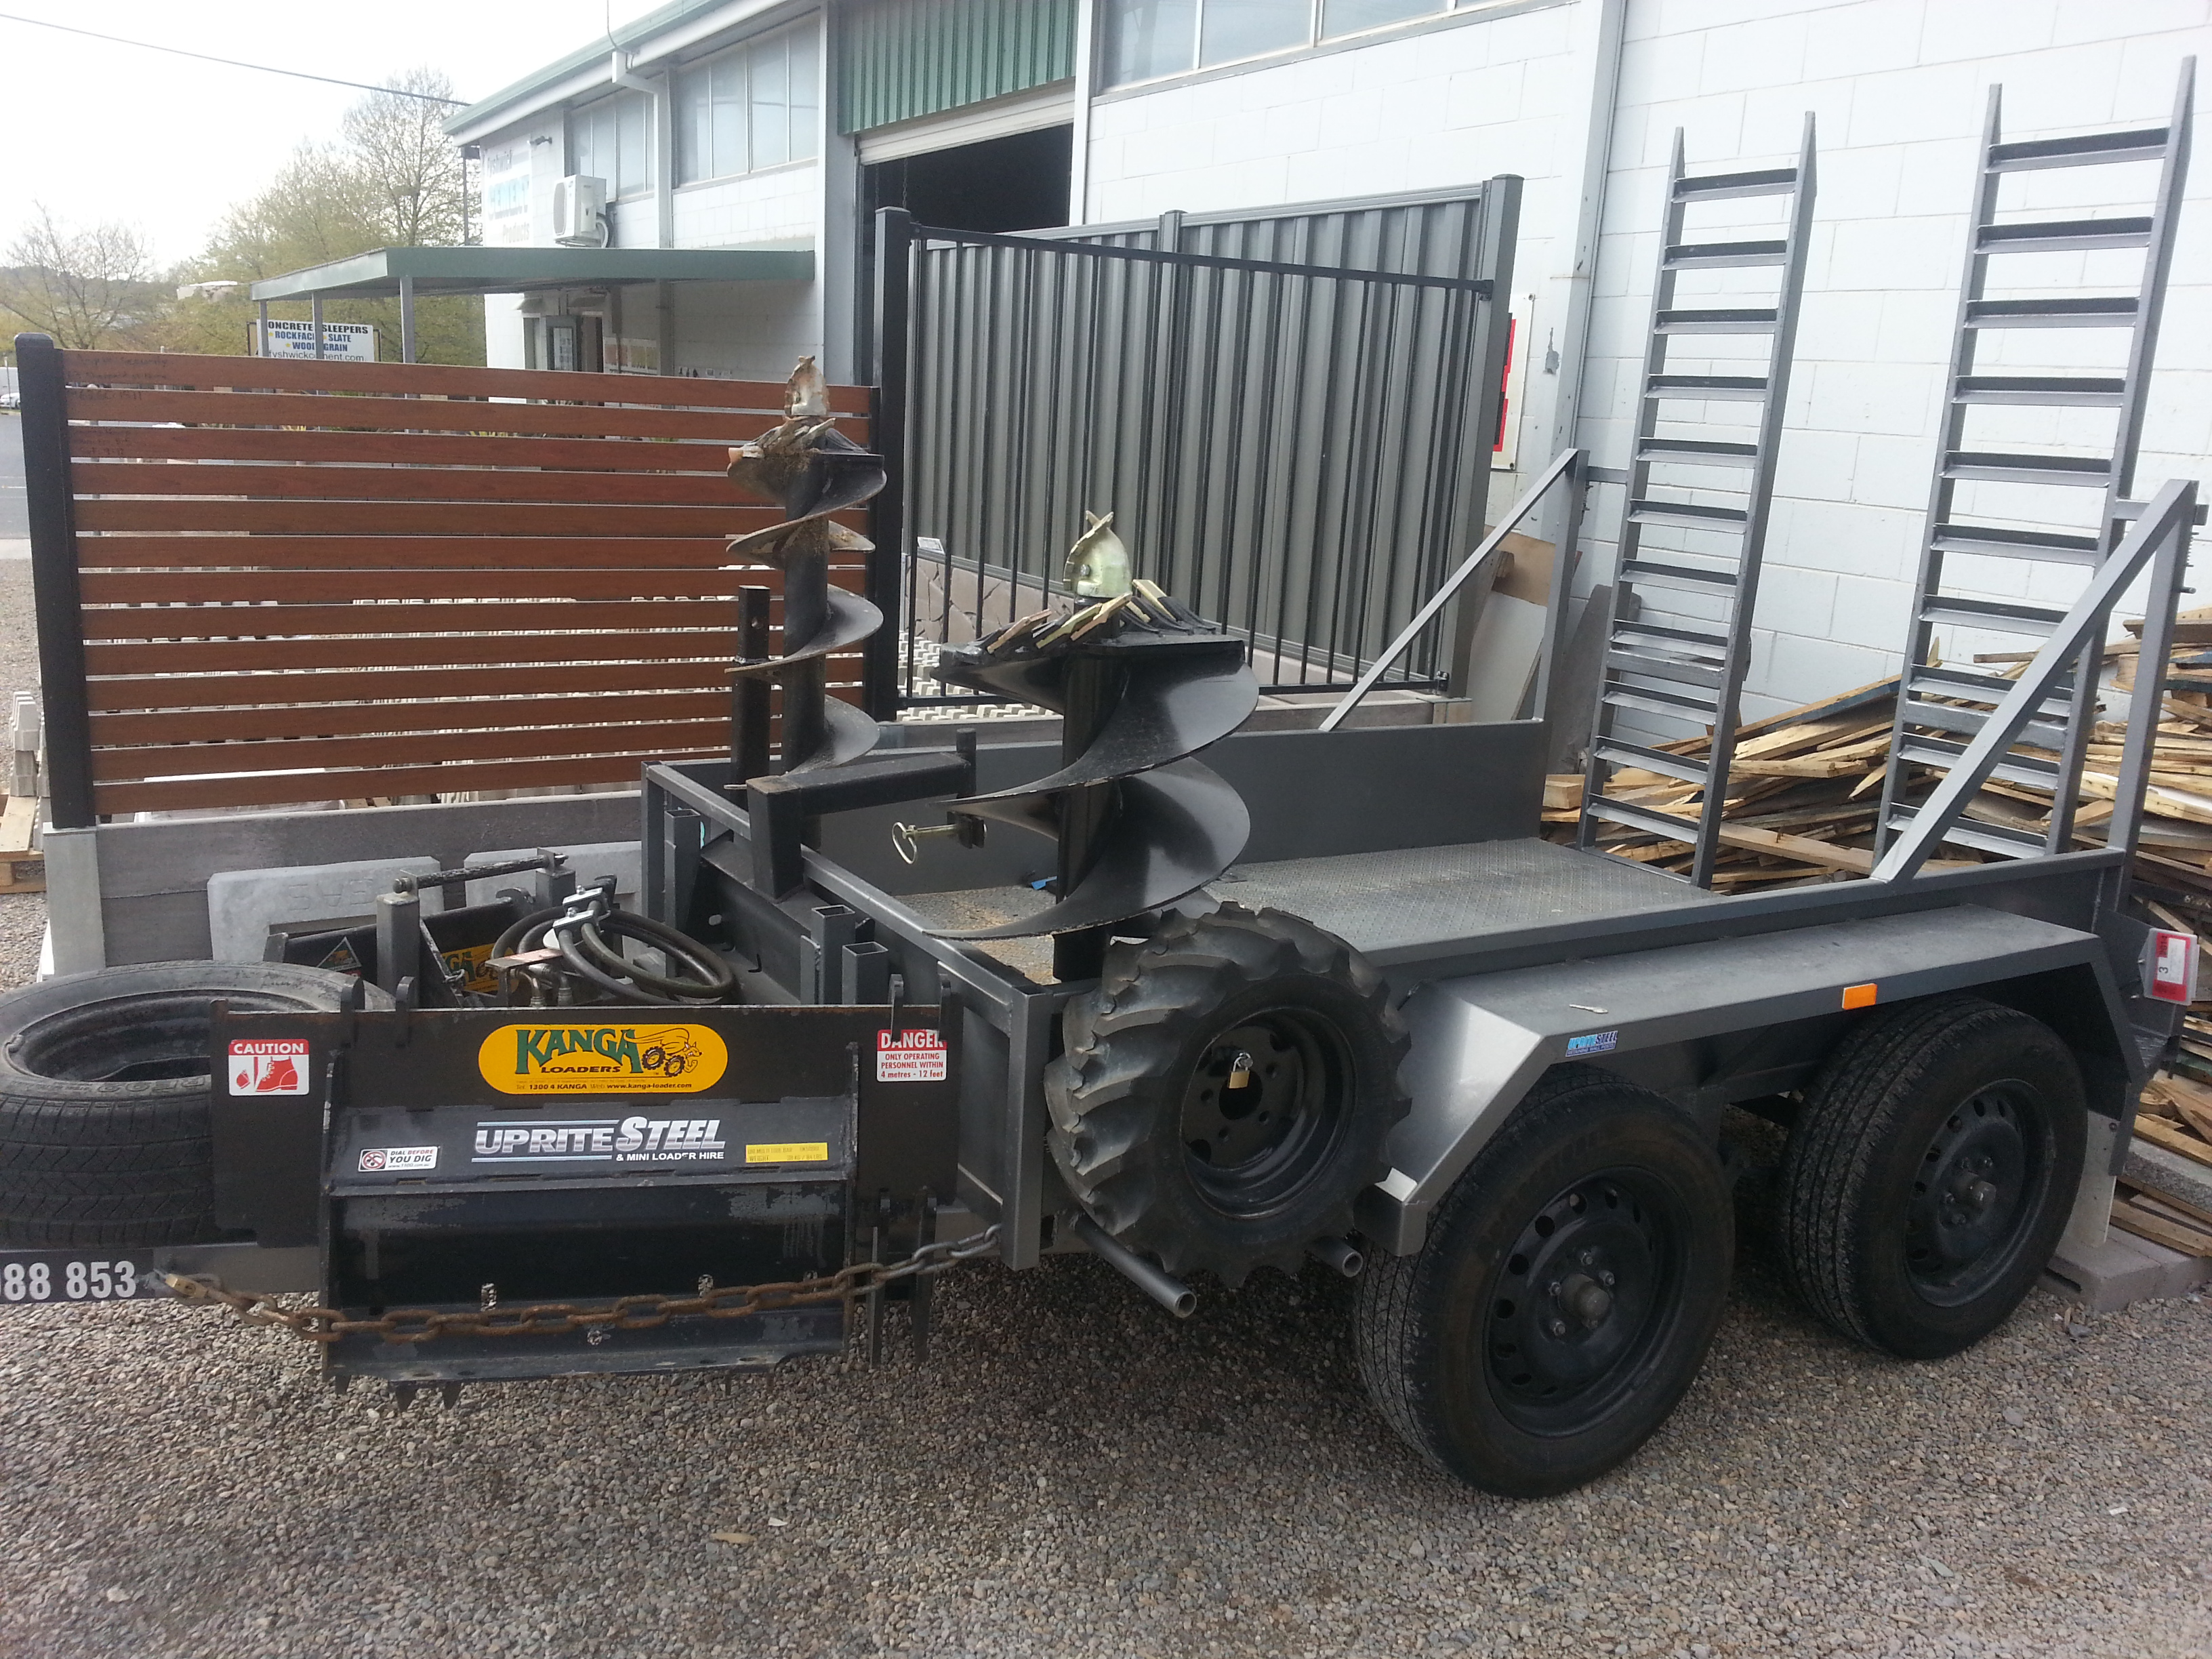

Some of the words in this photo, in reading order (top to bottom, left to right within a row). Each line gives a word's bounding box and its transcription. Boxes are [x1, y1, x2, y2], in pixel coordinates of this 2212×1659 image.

[268, 321, 313, 331] ONCRETE
[275, 331, 314, 340] ROCKFAC
[328, 334, 351, 343] SLATE
[234, 1043, 304, 1054] CAUTION
[515, 1028, 644, 1075] KANGA
[881, 1061, 918, 1069] PERSONNEL
[475, 1127, 615, 1154] UPRITE
[615, 1115, 726, 1151] STEEL
[615, 1153, 624, 1162] &
[626, 1153, 649, 1161] MINI
[699, 1151, 724, 1160] HIRE
[66, 1260, 136, 1298] 853
